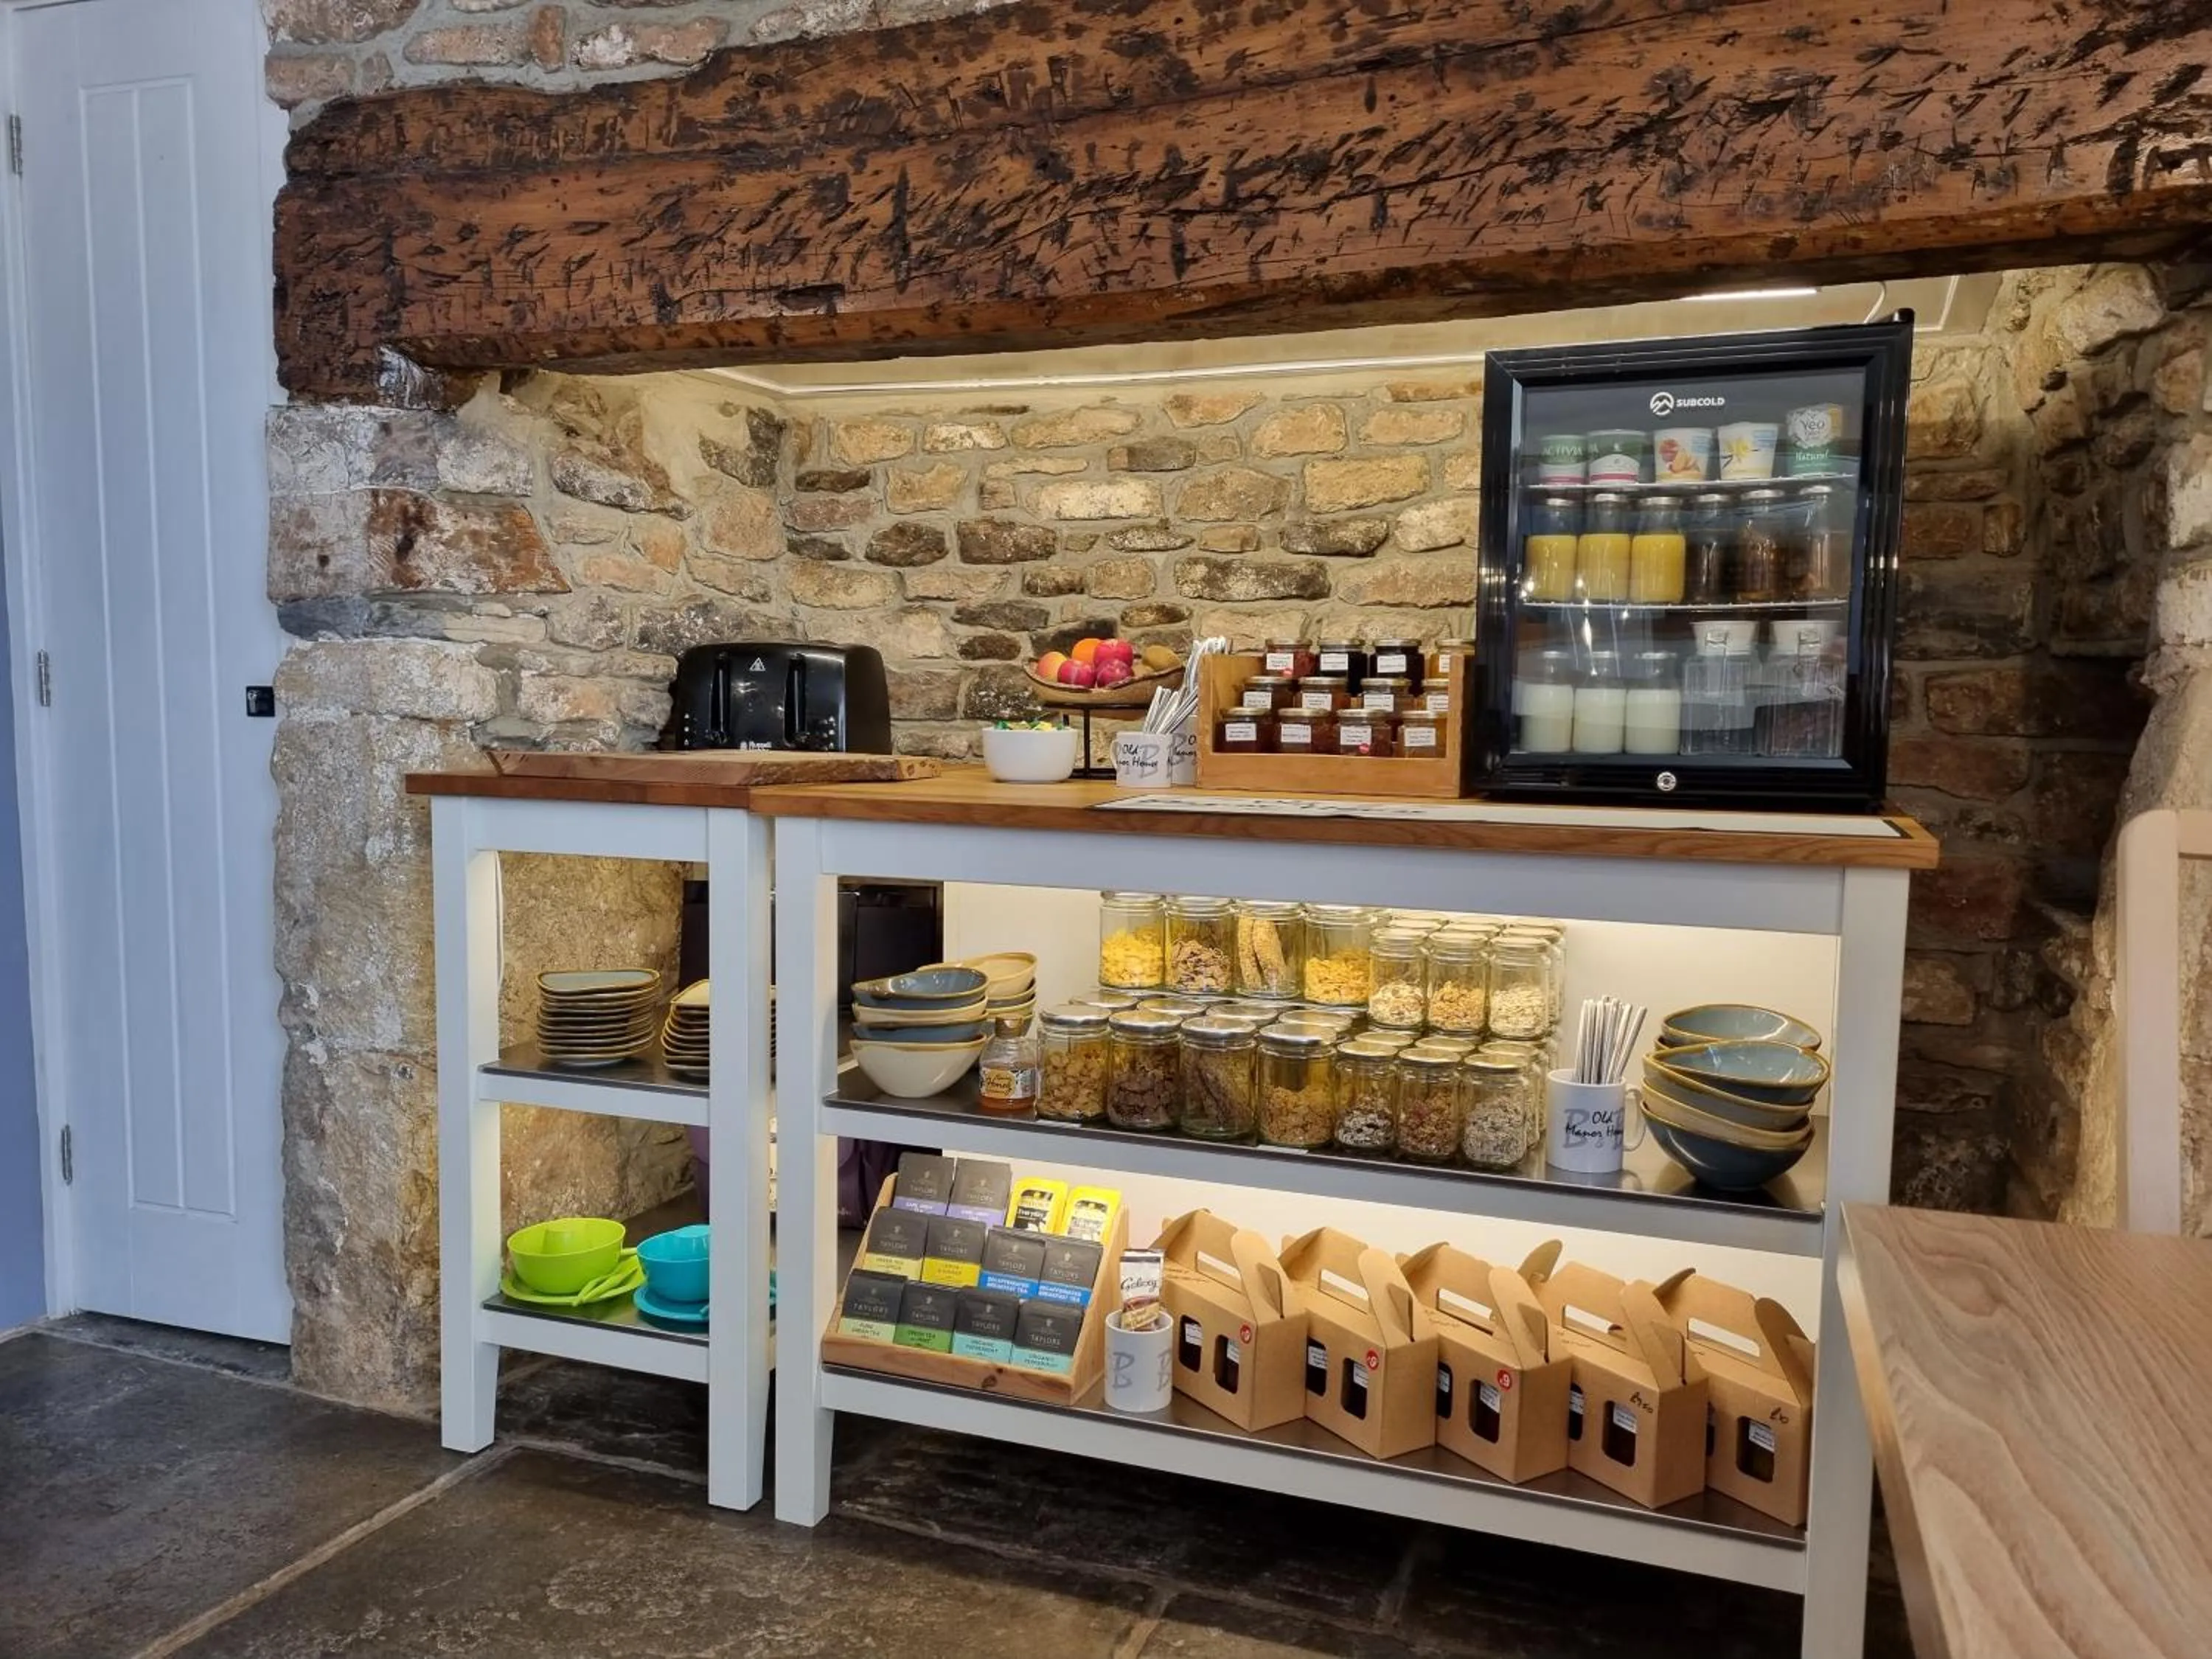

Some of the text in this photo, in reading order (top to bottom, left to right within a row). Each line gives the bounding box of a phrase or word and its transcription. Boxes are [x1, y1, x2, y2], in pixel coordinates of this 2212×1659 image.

[1676, 397, 1725, 408] SUBCOLD
[1795, 448, 1830, 462] Natural
[987, 1077, 1012, 1095] Honey
[1592, 1110, 1613, 1124] Old
[1565, 1123, 1603, 1137] Manor
[1120, 1276, 1158, 1293] Galaxy
